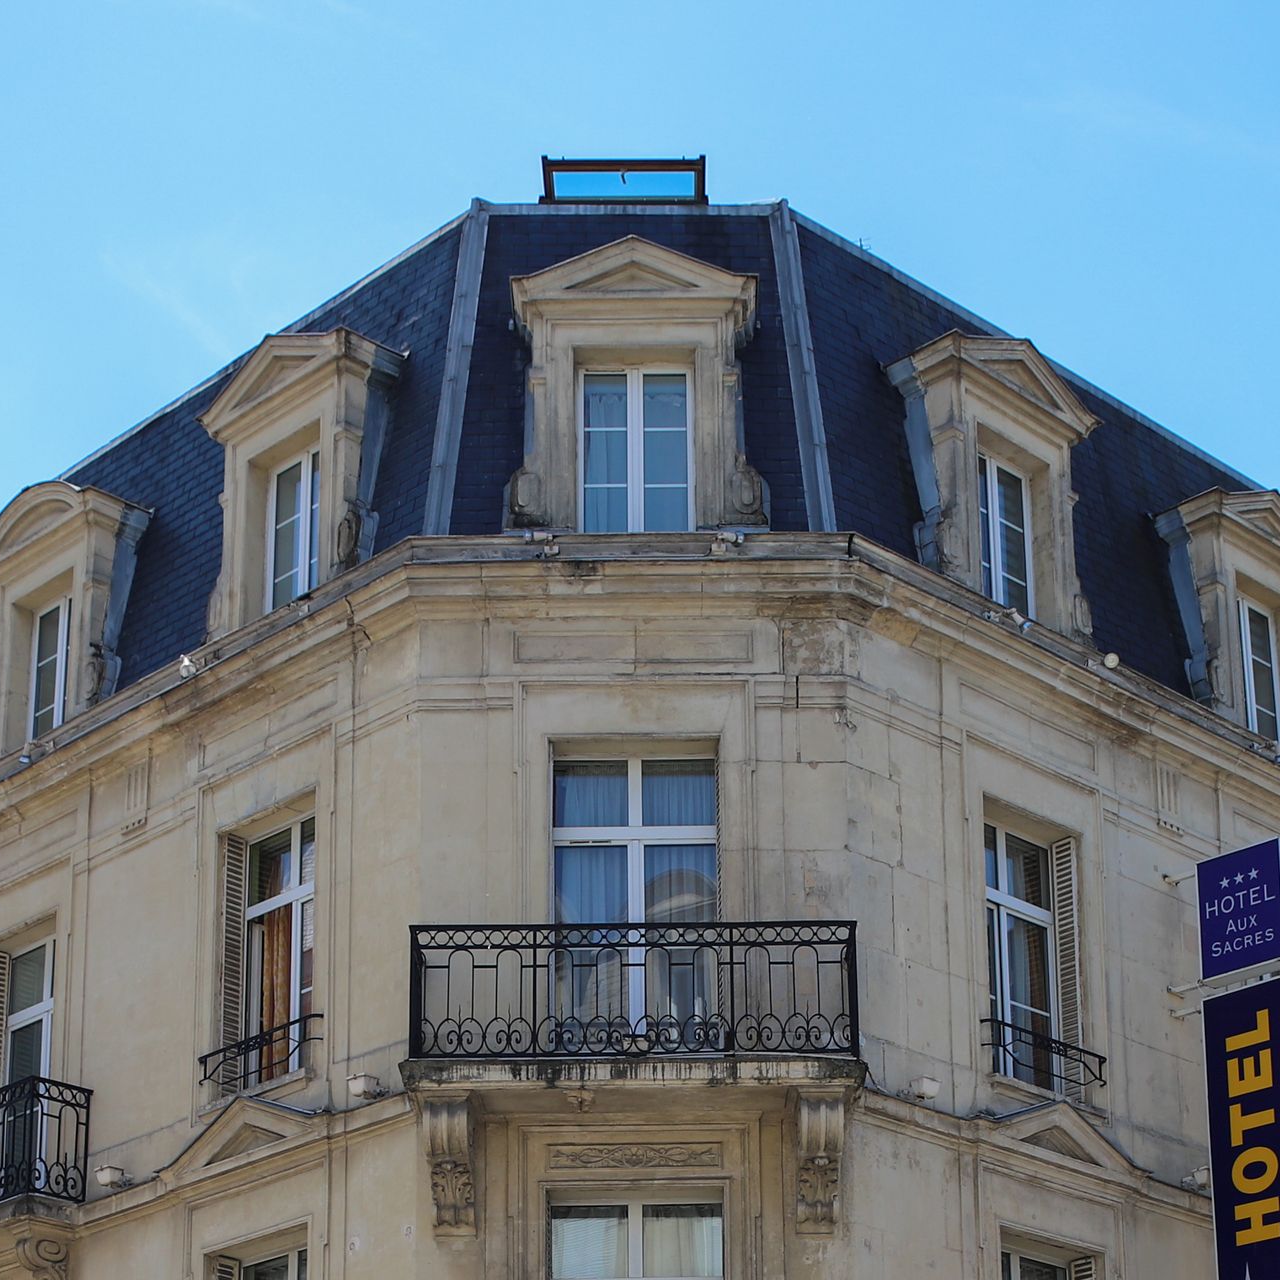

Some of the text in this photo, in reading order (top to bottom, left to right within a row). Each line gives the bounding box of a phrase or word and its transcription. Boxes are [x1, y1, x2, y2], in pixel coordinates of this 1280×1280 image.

[1205, 884, 1276, 919] HOTEL
[1226, 914, 1258, 935] AUX
[1211, 928, 1274, 957] SACRES
